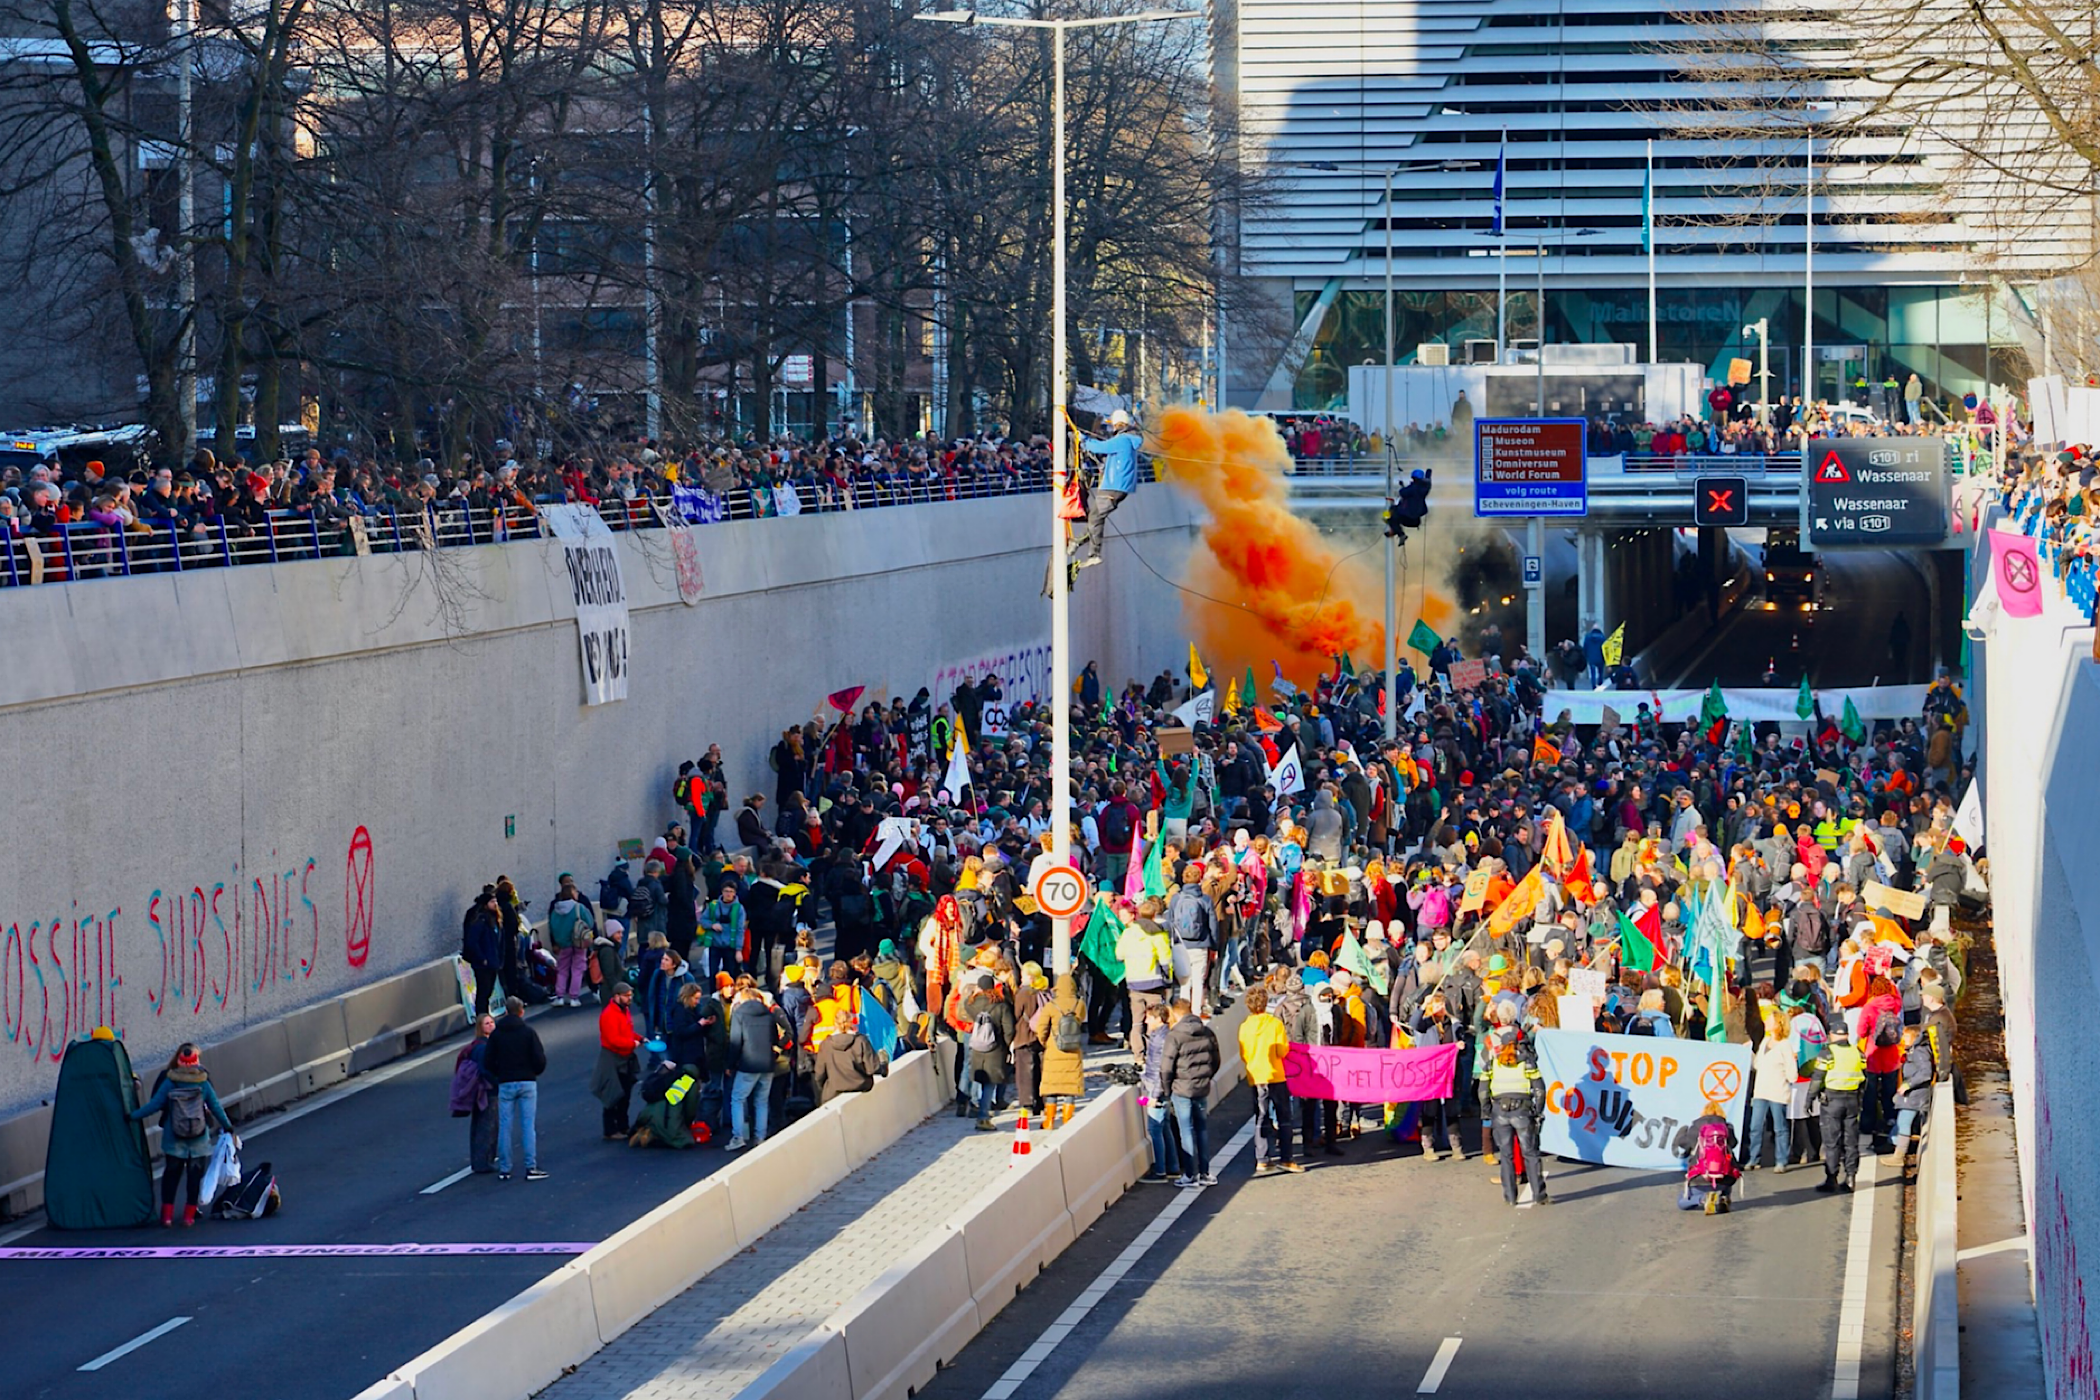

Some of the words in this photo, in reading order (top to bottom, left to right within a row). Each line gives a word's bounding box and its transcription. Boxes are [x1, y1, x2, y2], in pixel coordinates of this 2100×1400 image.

[1481, 425, 1542, 434] Madurodam
[1495, 437, 1535, 445] Museon
[1495, 448, 1567, 457] Kunstmuseum
[1905, 451, 1919, 463] ri
[1495, 459, 1558, 468] Omniversum
[1495, 470, 1526, 479] World
[1528, 470, 1560, 479] Forum
[1856, 469, 1932, 482] Wassenaar
[1505, 486, 1527, 497] volg
[1529, 487, 1557, 495] route
[1482, 500, 1580, 509] Scheveningen-Haven
[1833, 498, 1909, 511] Wassenaar
[1834, 518, 1855, 529] via
[1045, 882, 1077, 901] 70
[1285, 1053, 1341, 1081] STOP
[1347, 1069, 1372, 1088] MET
[1591, 1047, 1678, 1088] STOP
